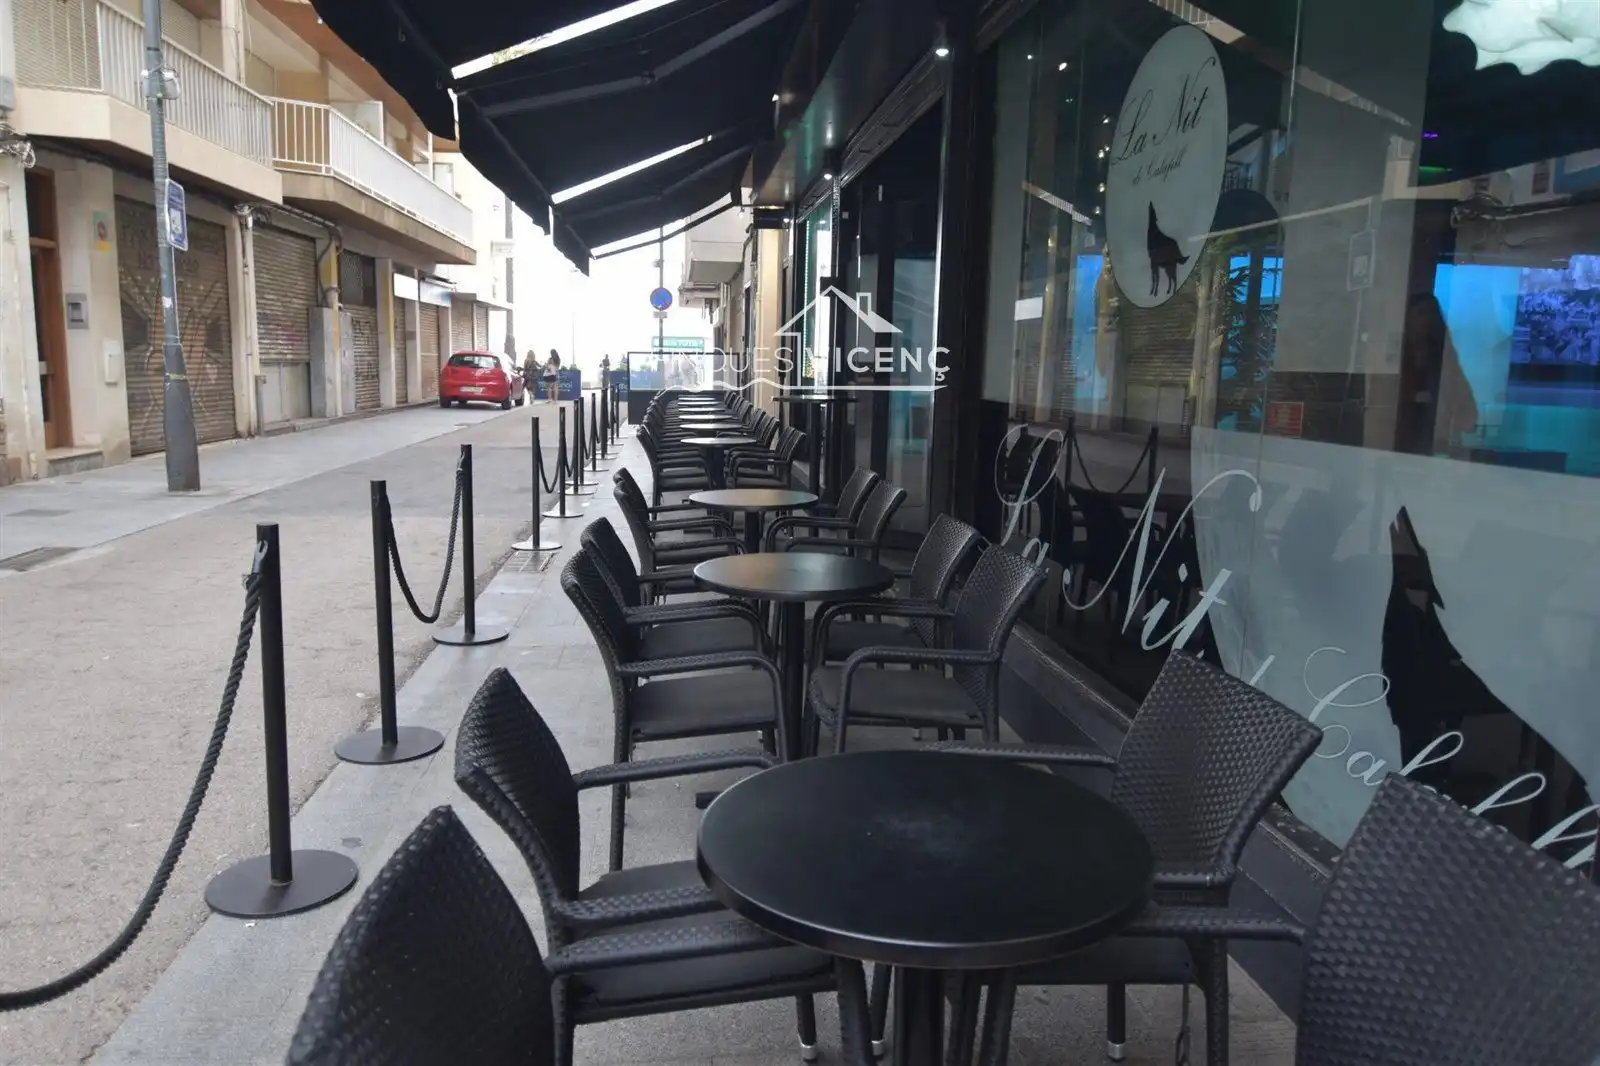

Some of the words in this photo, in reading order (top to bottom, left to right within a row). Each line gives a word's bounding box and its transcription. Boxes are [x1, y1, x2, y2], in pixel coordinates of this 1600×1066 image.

[1110, 88, 1153, 165] La
[1152, 56, 1216, 147] Nit
[1062, 466, 1263, 652] Nit
